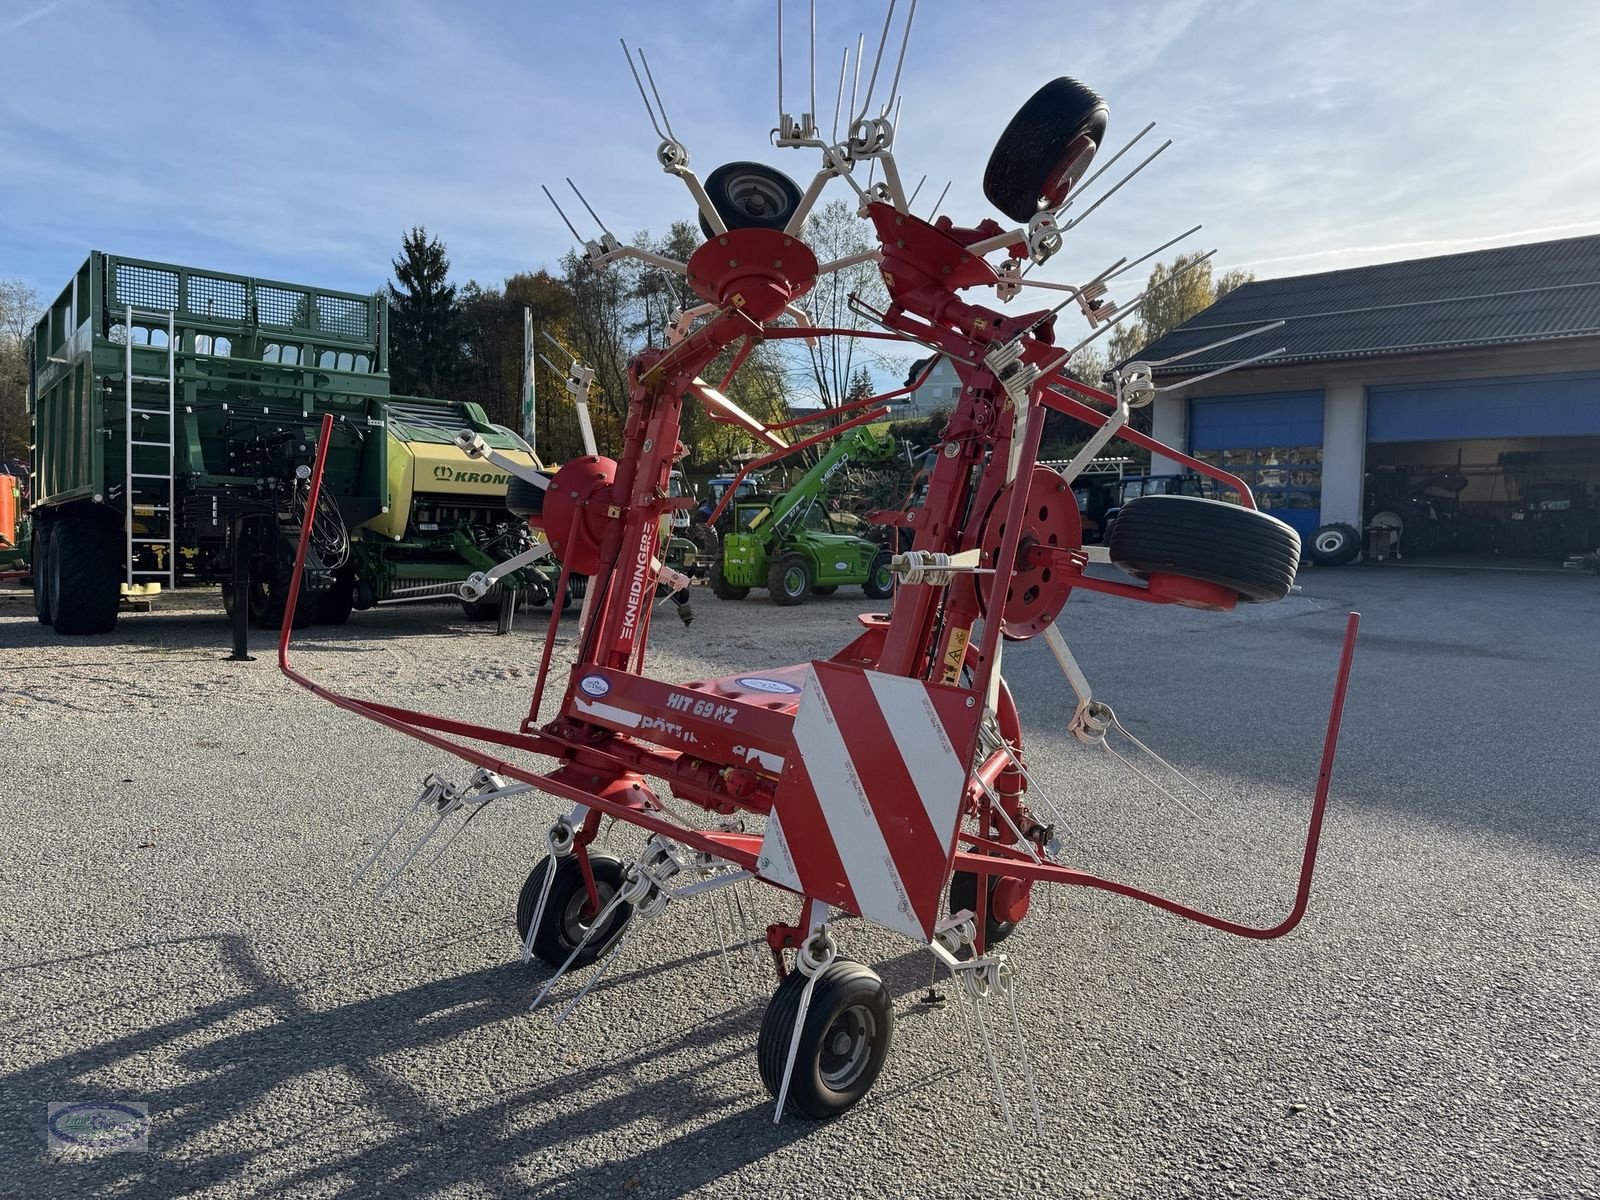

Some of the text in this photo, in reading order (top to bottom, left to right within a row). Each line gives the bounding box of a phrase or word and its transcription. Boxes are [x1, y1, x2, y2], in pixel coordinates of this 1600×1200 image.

[820, 452, 849, 485] MERLO
[623, 534, 652, 627] KNEIDINGER
[665, 692, 694, 712] HIT
[693, 699, 715, 718] 69
